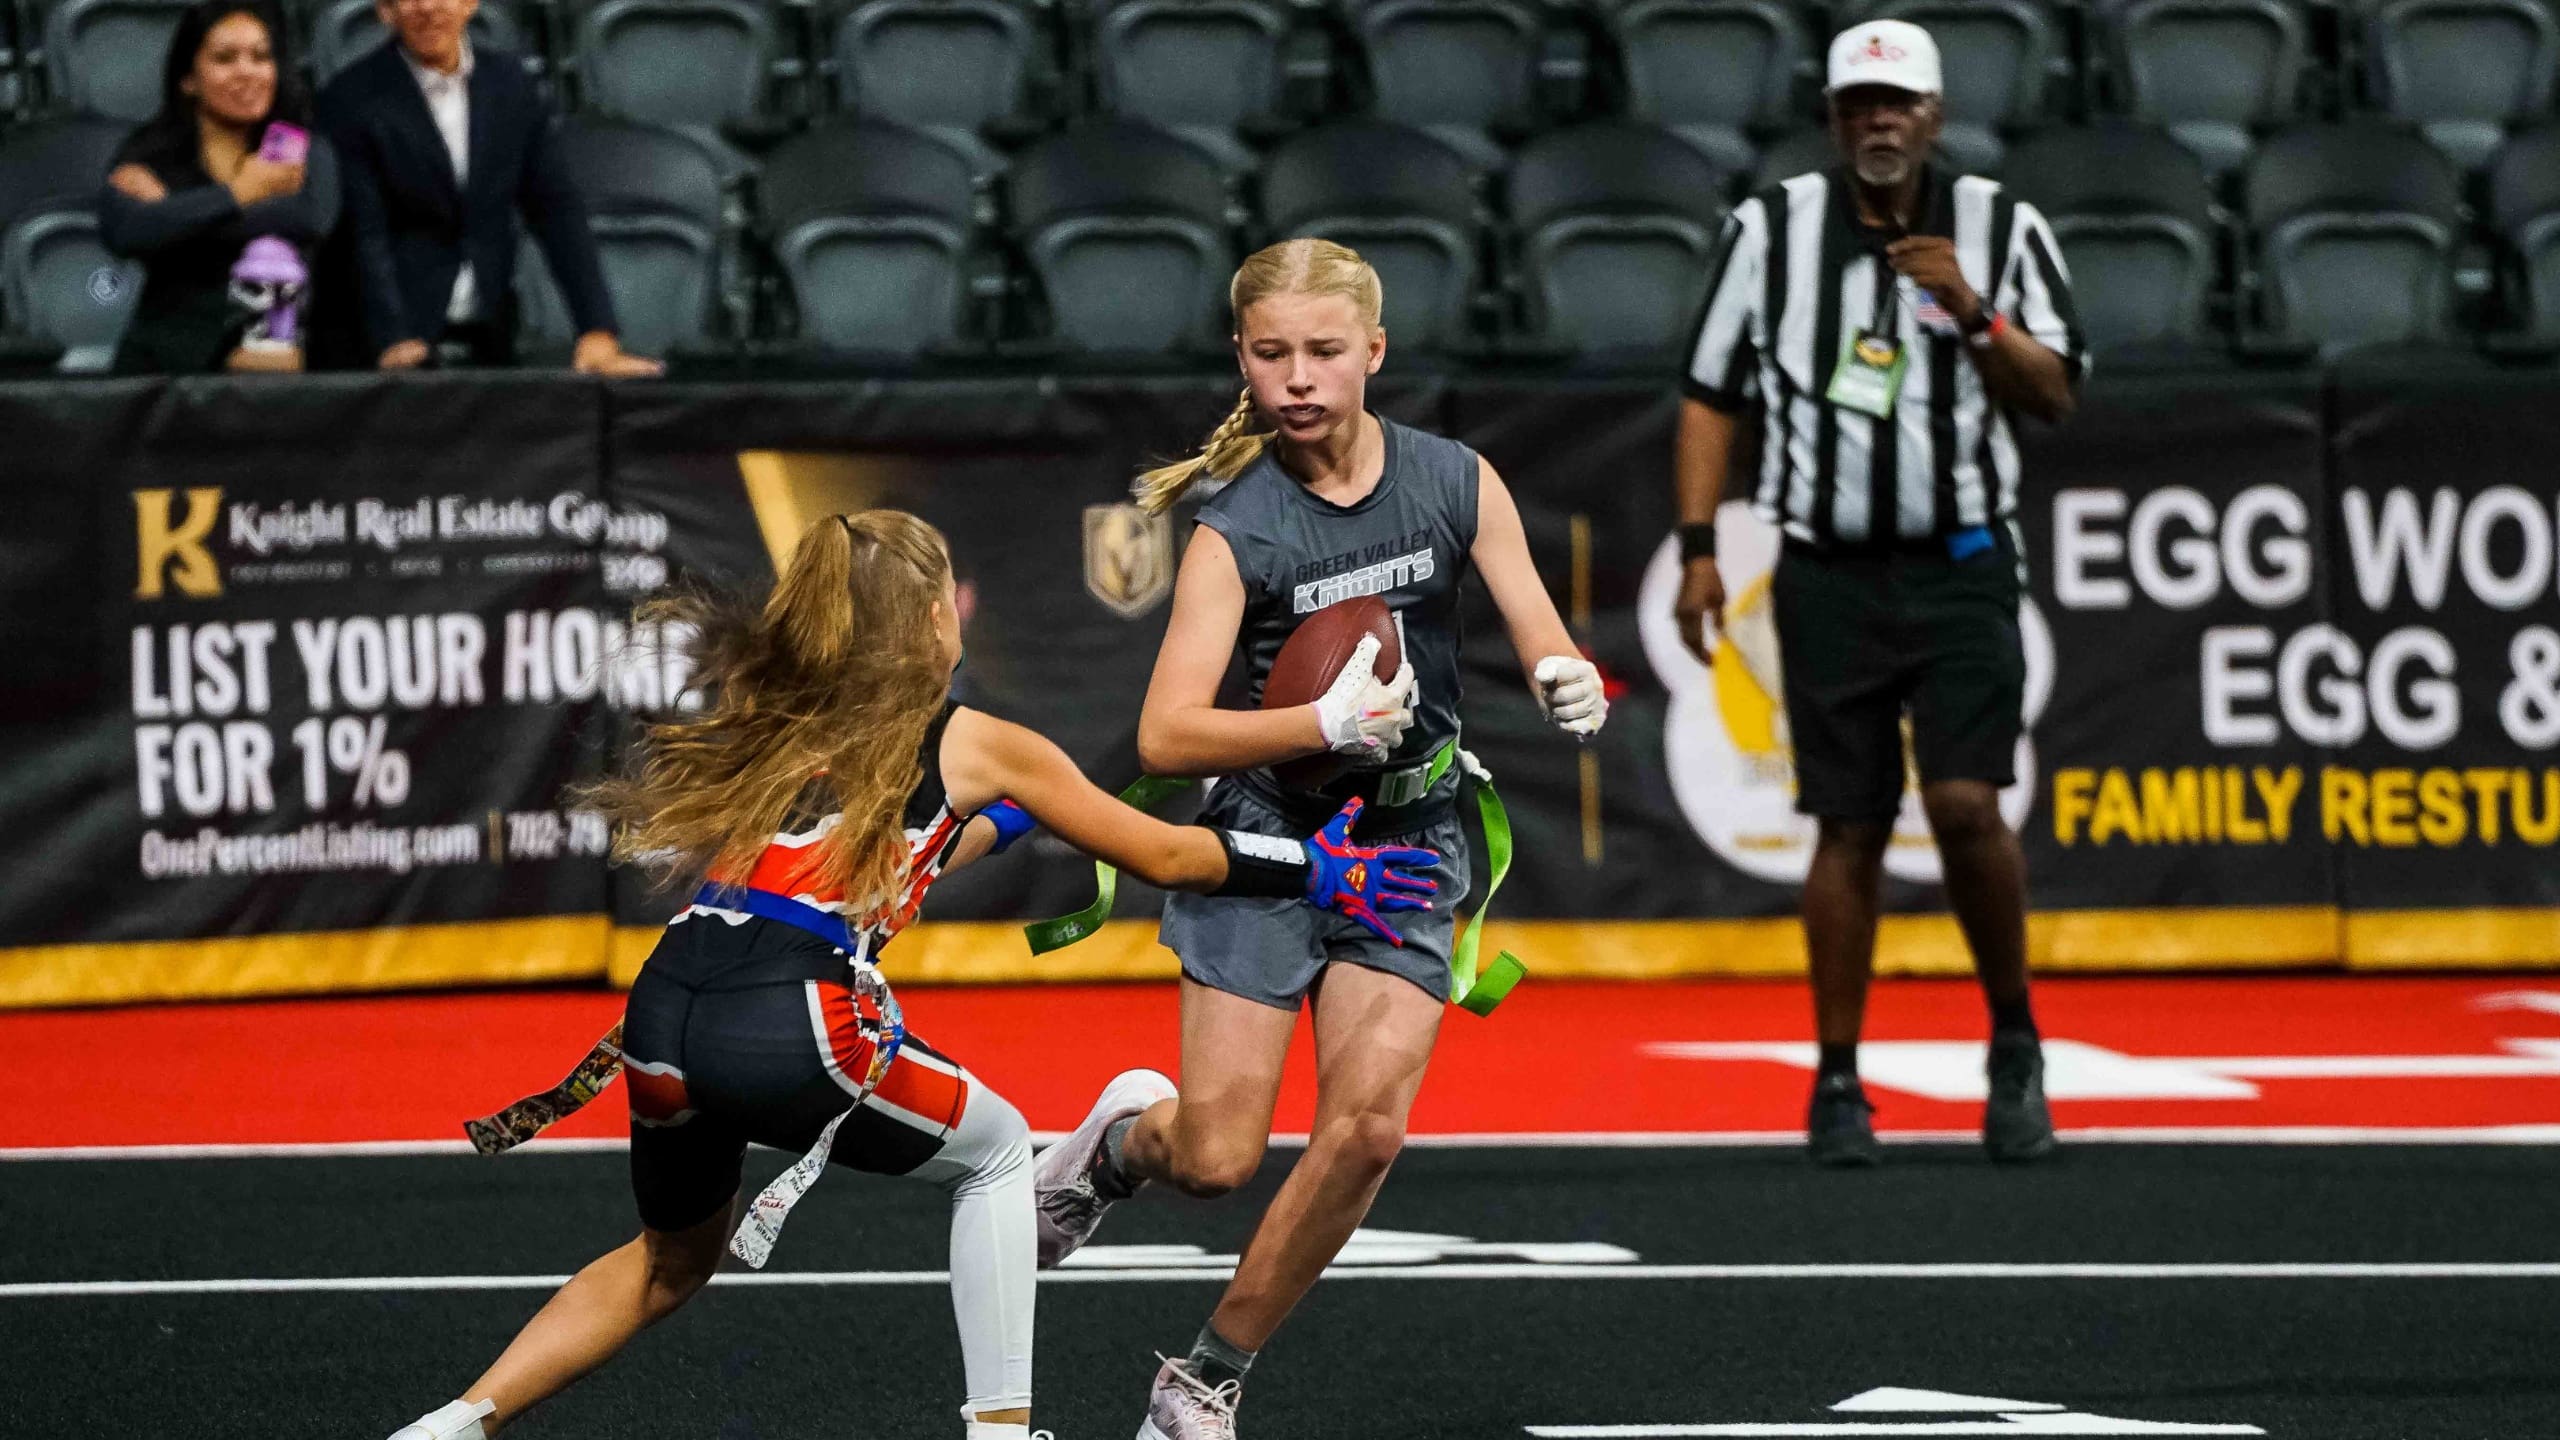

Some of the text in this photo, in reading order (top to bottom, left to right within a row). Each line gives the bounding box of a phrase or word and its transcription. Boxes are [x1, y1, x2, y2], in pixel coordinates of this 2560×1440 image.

[230, 500, 347, 554] Knight
[355, 499, 433, 550] Real
[438, 496, 544, 544] Estate
[1295, 528, 1434, 582] GREEN VALLEY
[2053, 483, 2560, 612] EGG WO
[1294, 547, 1435, 614] KNIGHTS
[132, 620, 277, 718] LIST
[291, 611, 487, 714] YOUR
[2200, 622, 2560, 750] EGG &
[136, 713, 410, 816] FOR 1%
[2053, 764, 2560, 846] FAMILY RESTU
[140, 820, 480, 880] OnePercentListing.com
